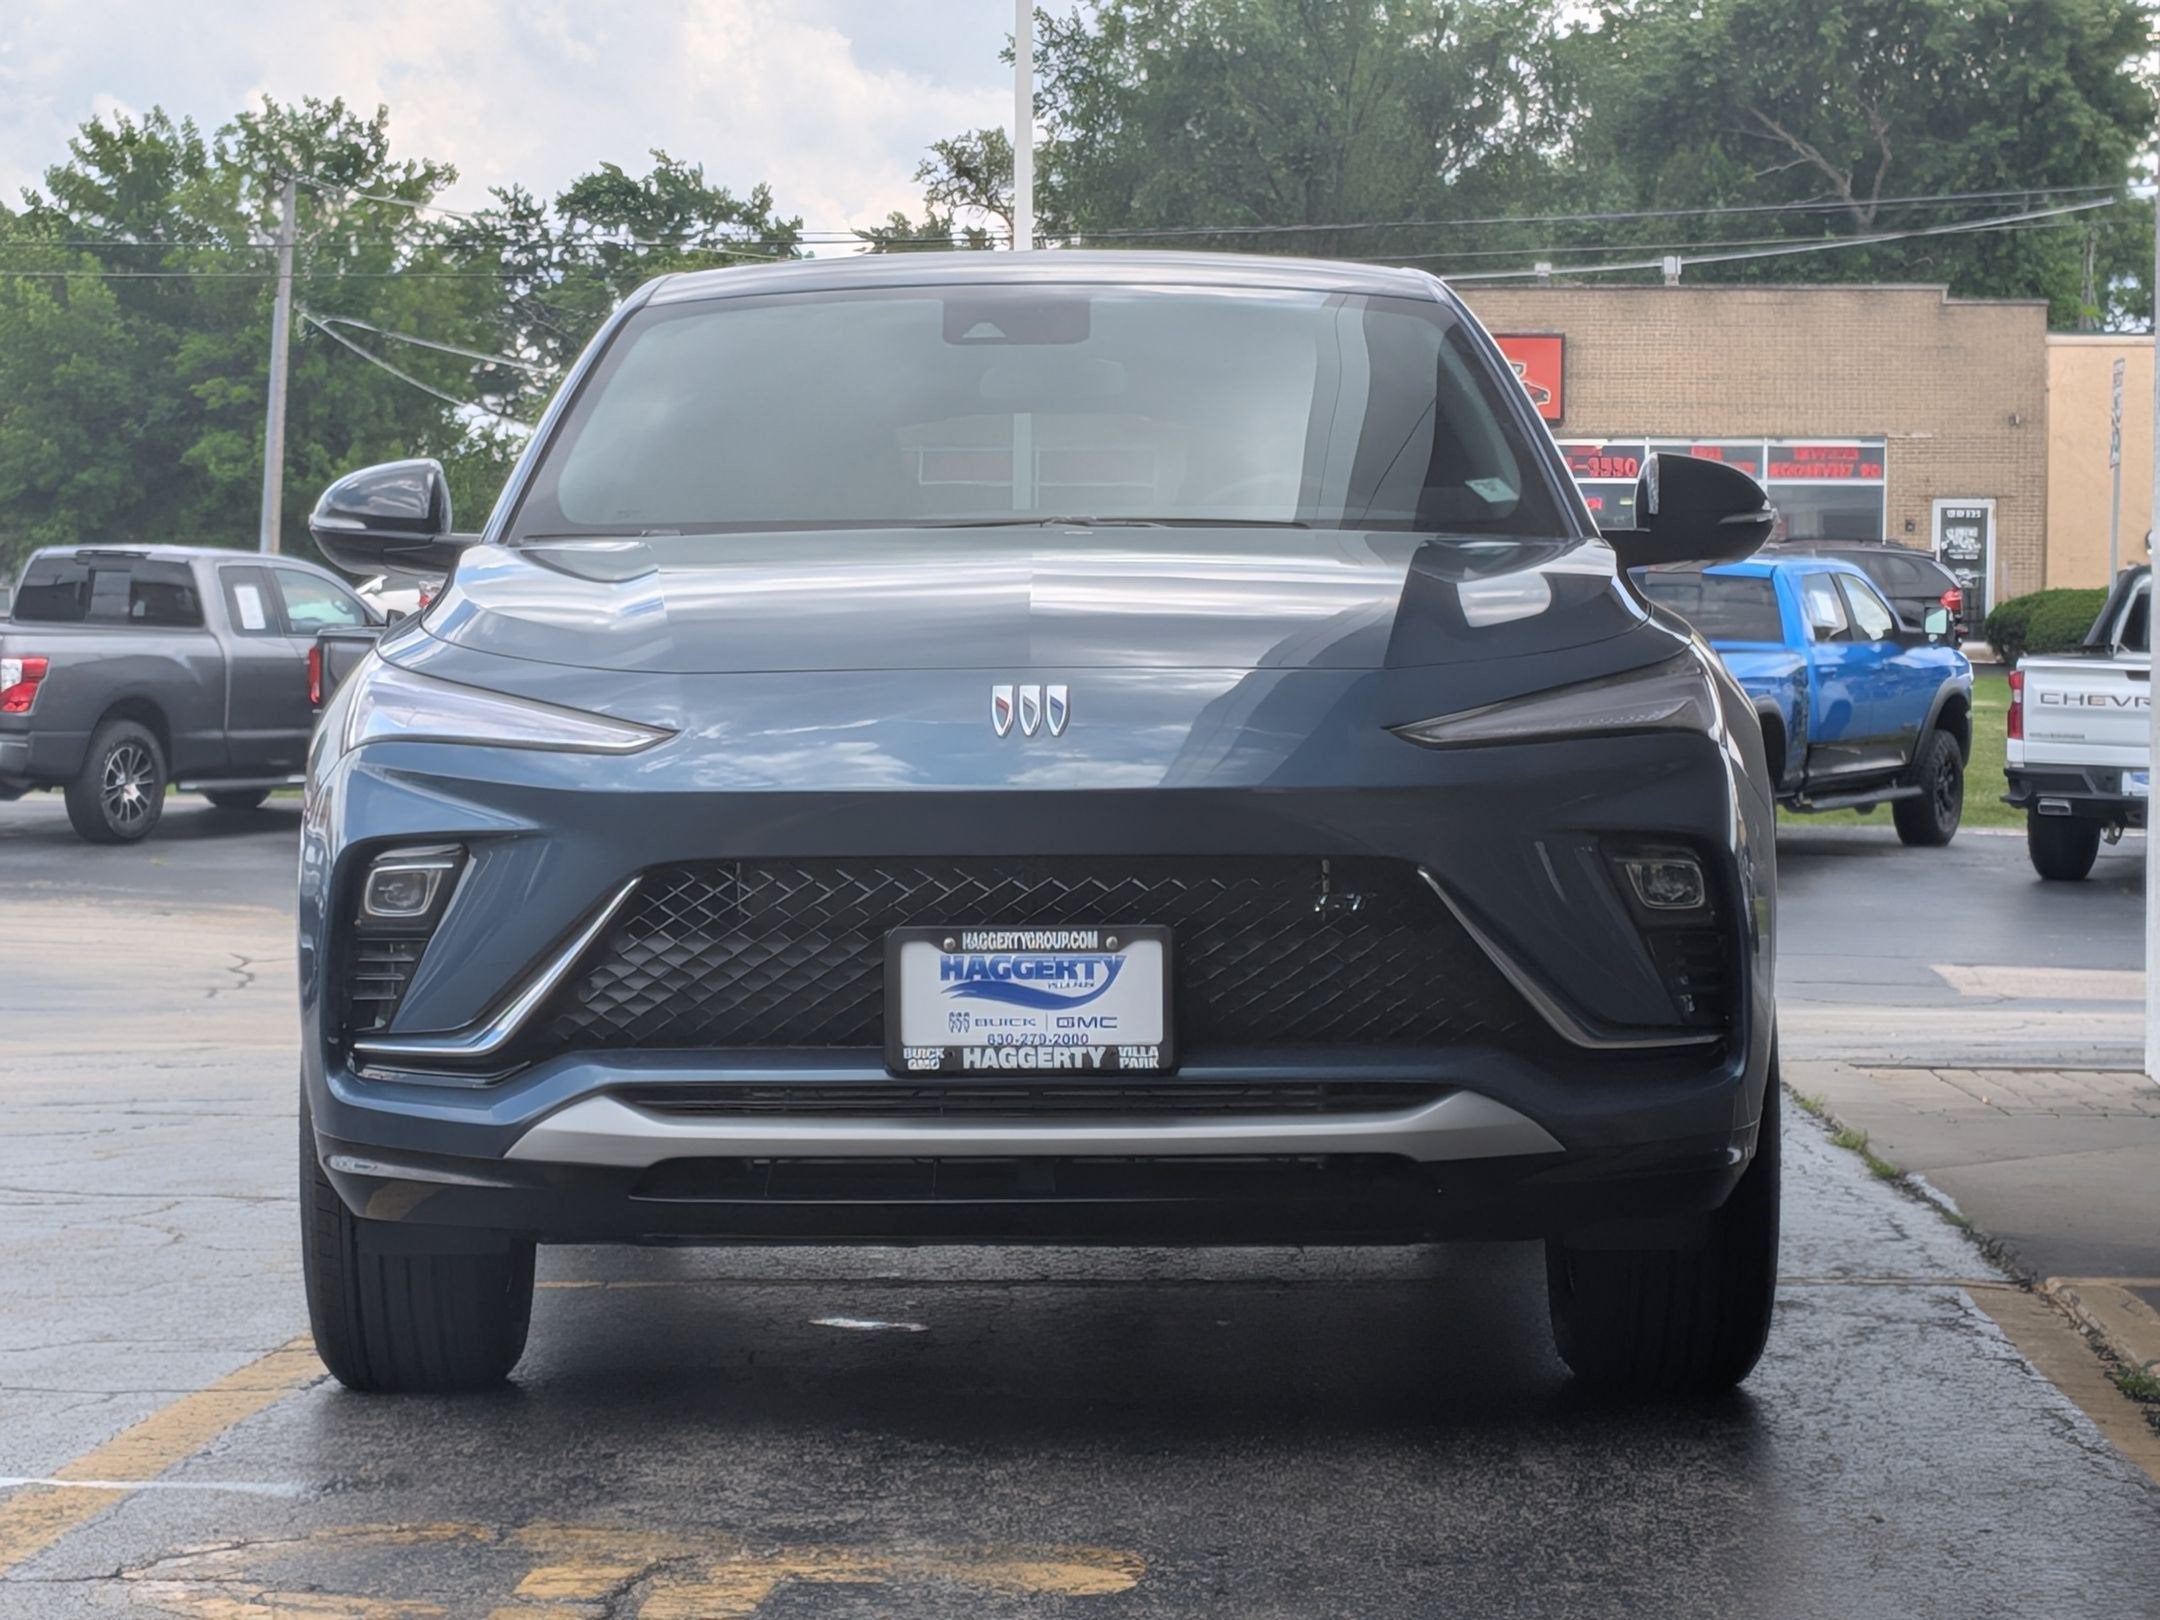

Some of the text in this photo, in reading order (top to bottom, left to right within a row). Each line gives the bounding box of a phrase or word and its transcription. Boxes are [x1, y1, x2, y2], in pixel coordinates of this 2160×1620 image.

[962, 931, 1098, 950] HAGGERTYGROUP.COM
[940, 954, 1127, 981] HAGGERTY
[975, 1016, 1118, 1029] BUICK GMC
[903, 1047, 945, 1059] BUICK
[963, 1047, 1106, 1069] HAGGERTY
[1118, 1046, 1158, 1057] VILLA
[1119, 1057, 1159, 1069] PARK
